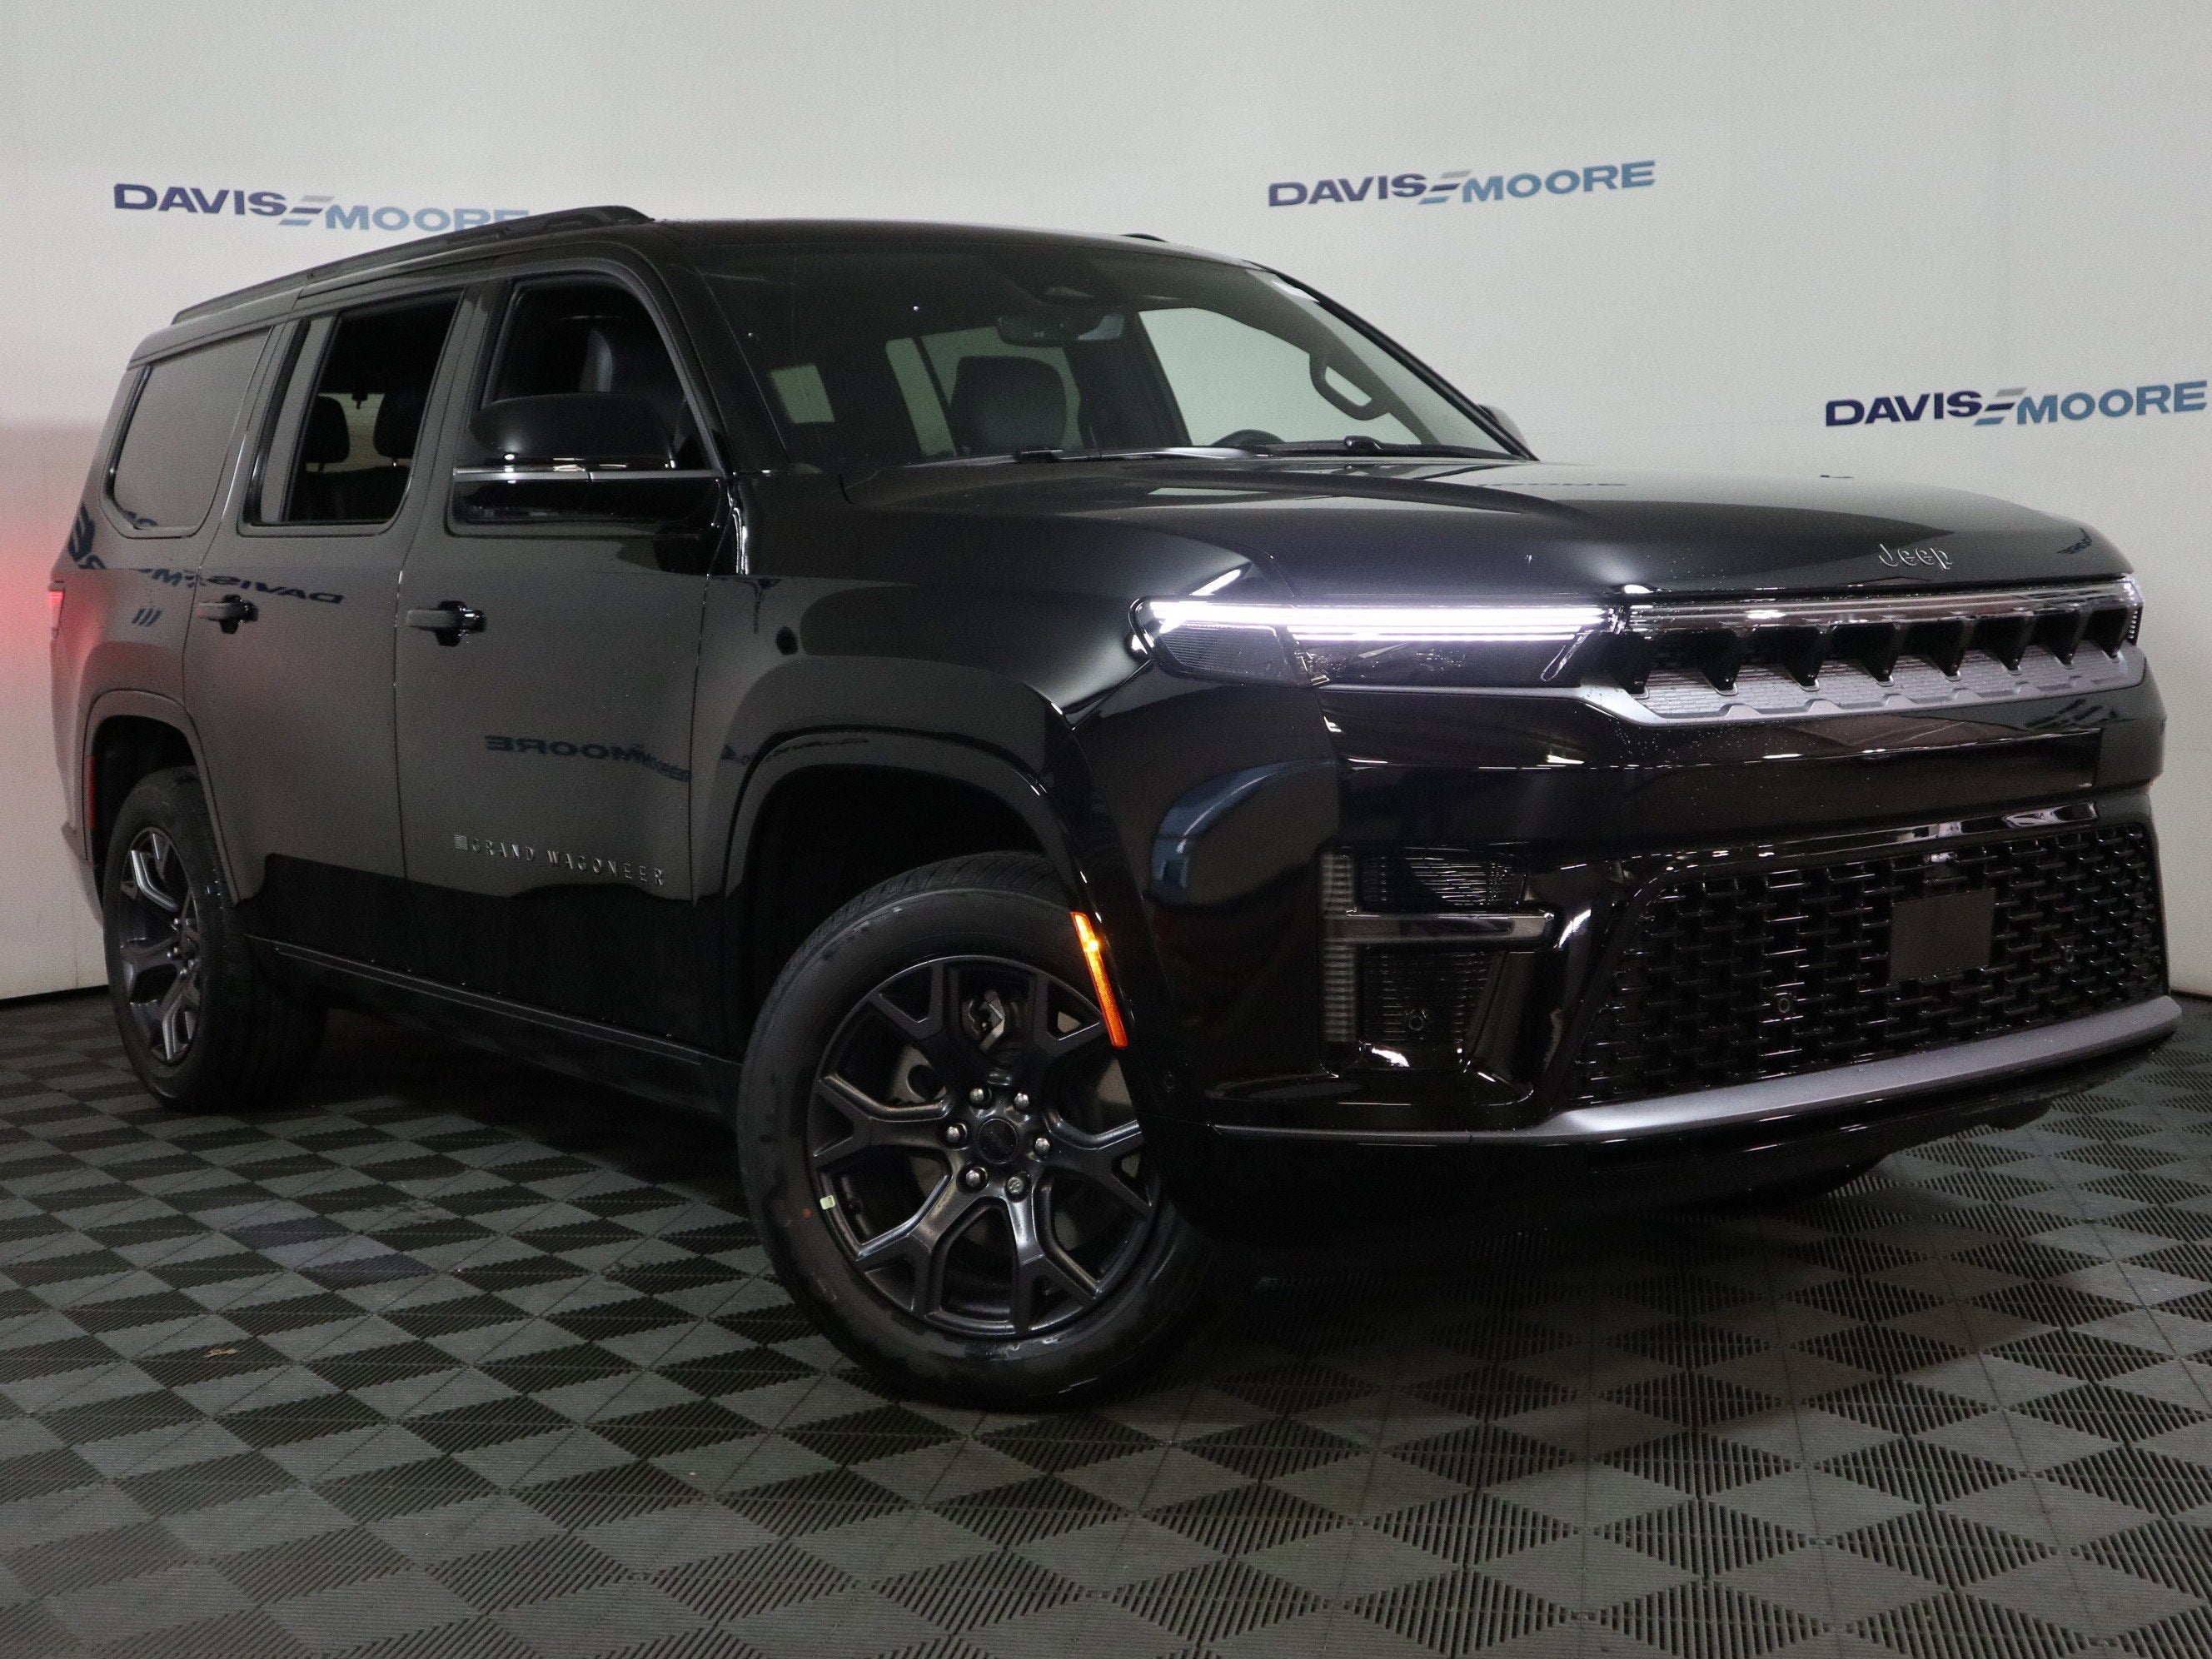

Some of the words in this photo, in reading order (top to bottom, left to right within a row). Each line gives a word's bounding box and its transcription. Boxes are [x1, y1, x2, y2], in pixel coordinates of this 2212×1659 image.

[113, 183, 288, 217] DAVIS
[1268, 172, 1428, 207] DAVIS
[1462, 160, 1656, 203] MOORE
[1825, 390, 1984, 427] DAVIS
[2015, 380, 2208, 426] MOORE
[1878, 543, 1954, 570] Jeep
[472, 838, 536, 862] GRAND
[546, 849, 664, 887] WAGONEER
